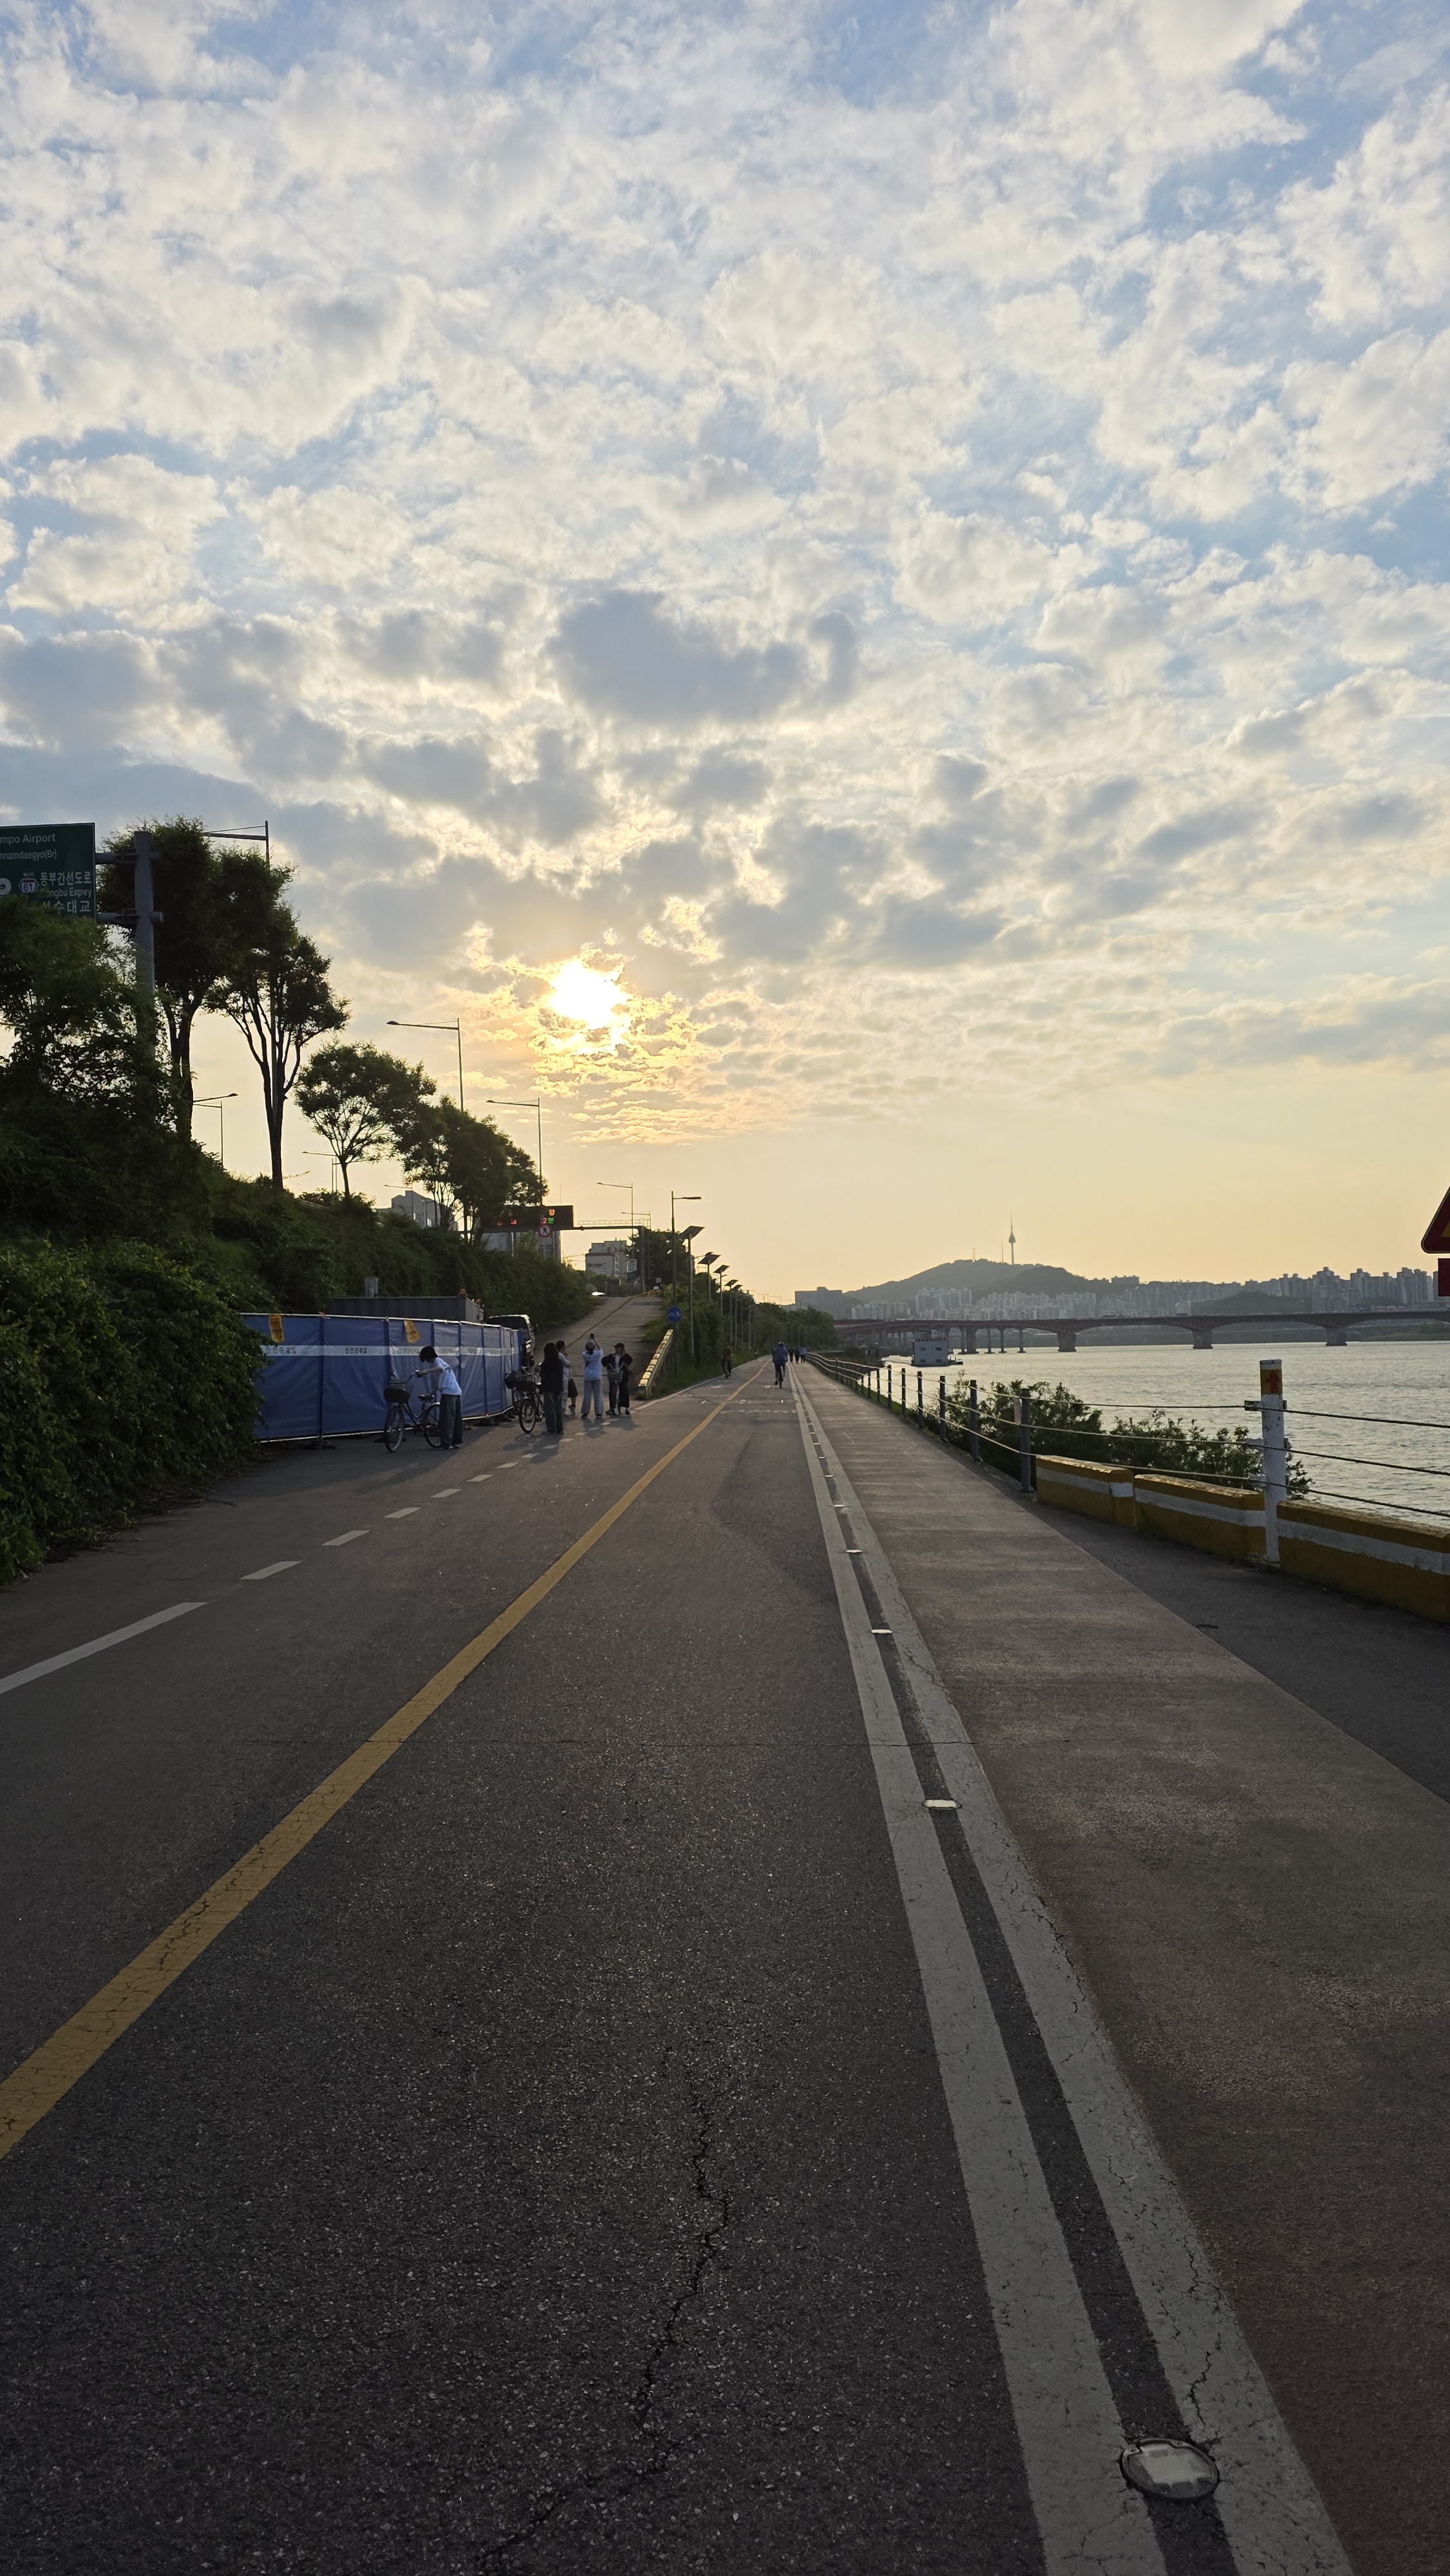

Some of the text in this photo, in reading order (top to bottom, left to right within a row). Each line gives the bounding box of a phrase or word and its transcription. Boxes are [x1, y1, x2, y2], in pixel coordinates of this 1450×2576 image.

[23, 833, 55, 844] Airport
[40, 871, 91, 886] 동부간선도로
[23, 883, 32, 891] 61
[42, 887, 91, 899] ngbu Expwy
